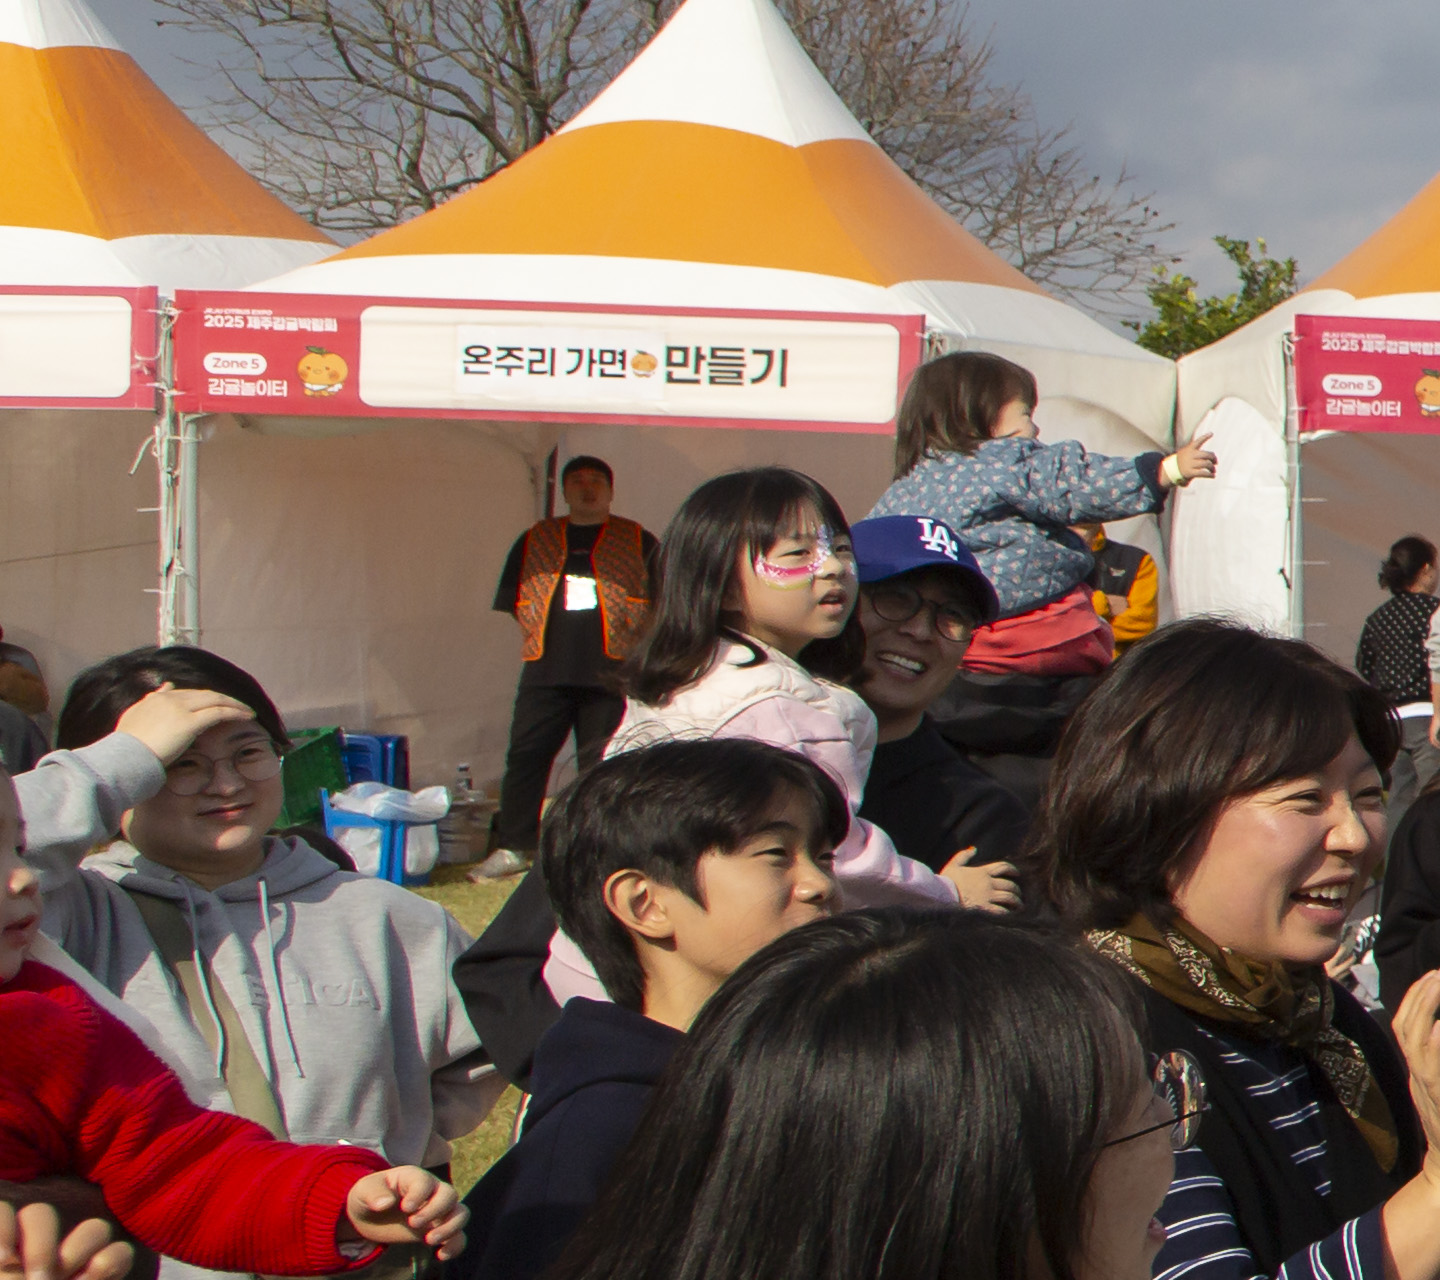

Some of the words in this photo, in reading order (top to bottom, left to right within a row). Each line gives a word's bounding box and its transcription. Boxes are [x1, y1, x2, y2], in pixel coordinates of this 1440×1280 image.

[204, 314, 245, 328] 2025
[1321, 338, 1359, 351] 2025
[212, 358, 249, 370] Zone
[251, 359, 260, 370] 5
[462, 345, 556, 377] 온주리
[566, 347, 627, 378] 가면
[665, 345, 789, 387] 만들기
[208, 378, 288, 397] 감귤놀이터
[1330, 378, 1364, 390] Zone
[1367, 379, 1375, 390] 5
[1326, 399, 1402, 417] 감귤놀이터
[917, 518, 958, 561] LA
